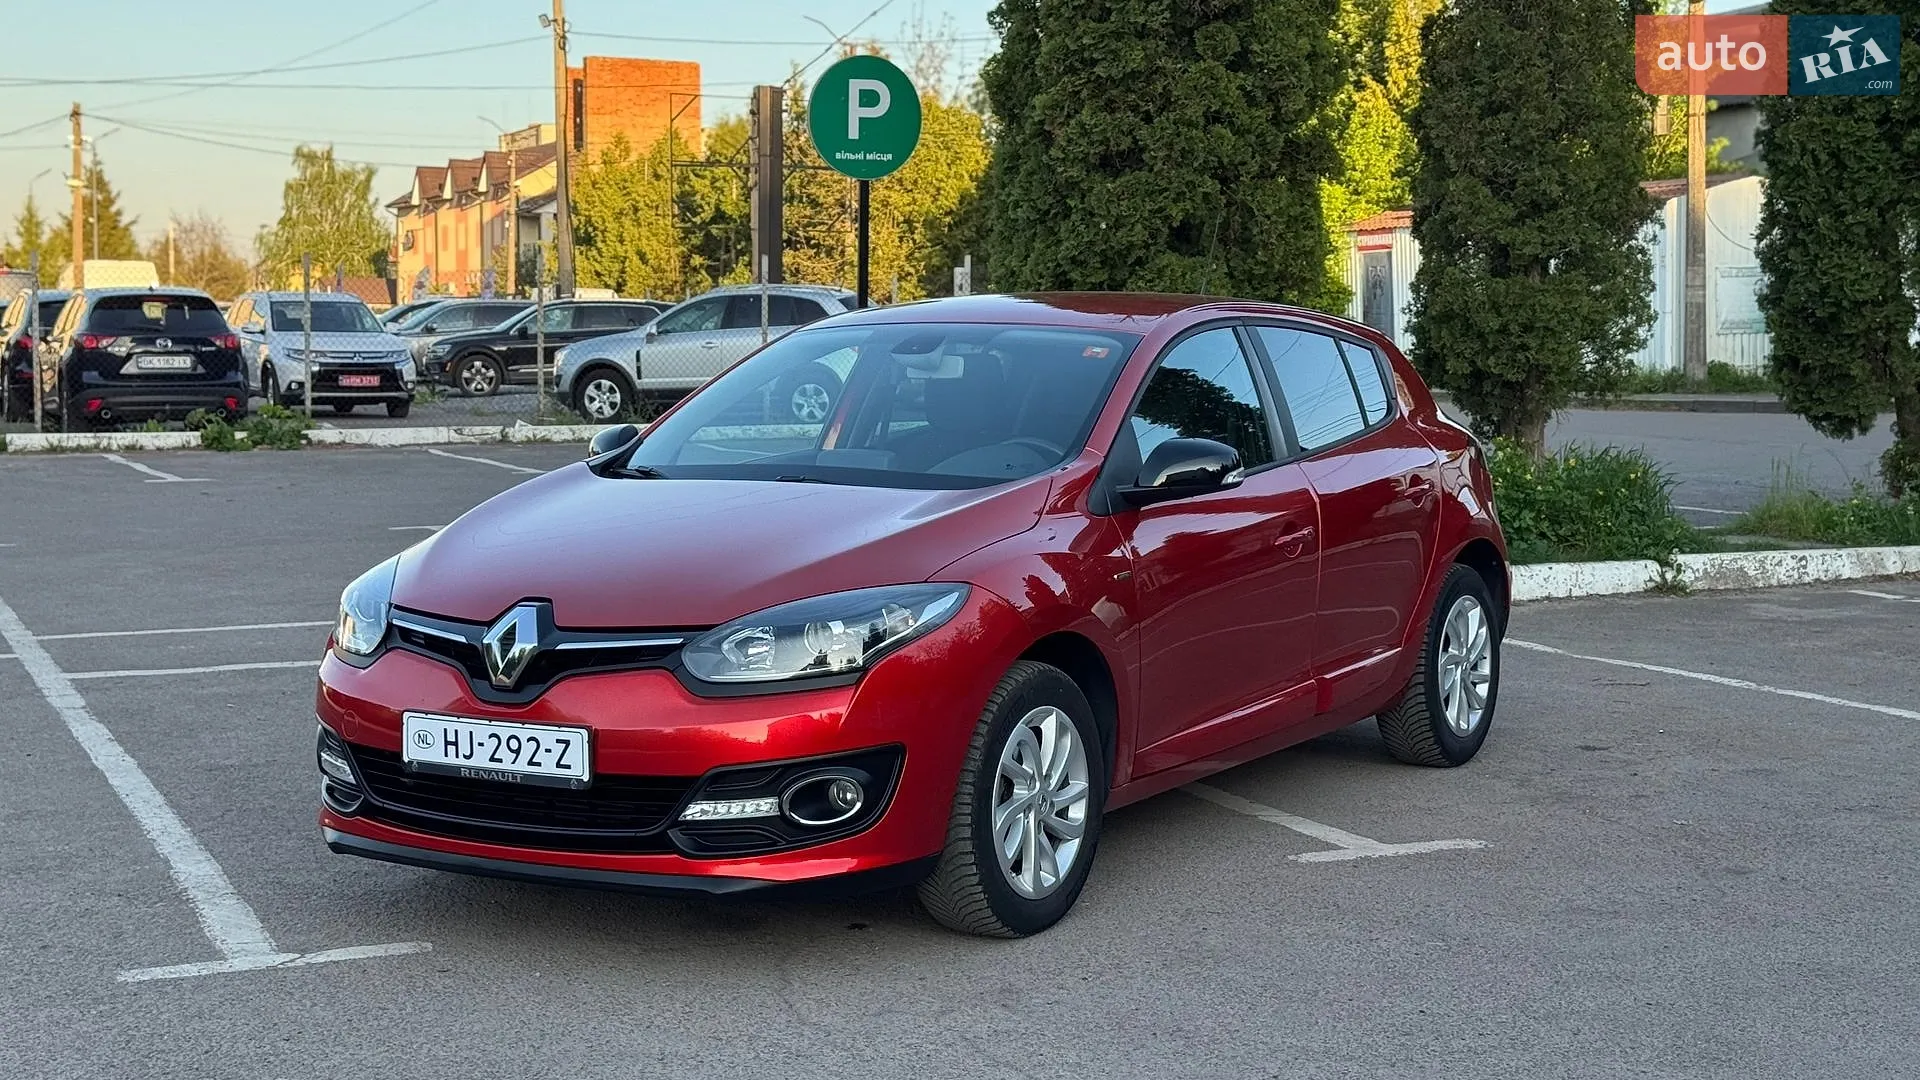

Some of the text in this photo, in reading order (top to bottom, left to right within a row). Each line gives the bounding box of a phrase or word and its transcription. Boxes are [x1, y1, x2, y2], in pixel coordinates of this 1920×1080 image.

[847, 78, 891, 140] P
[835, 150, 893, 162] вільні місця
[417, 732, 431, 746] NL
[443, 728, 572, 770] HJ-292-Z
[460, 767, 524, 783] RENAULT
